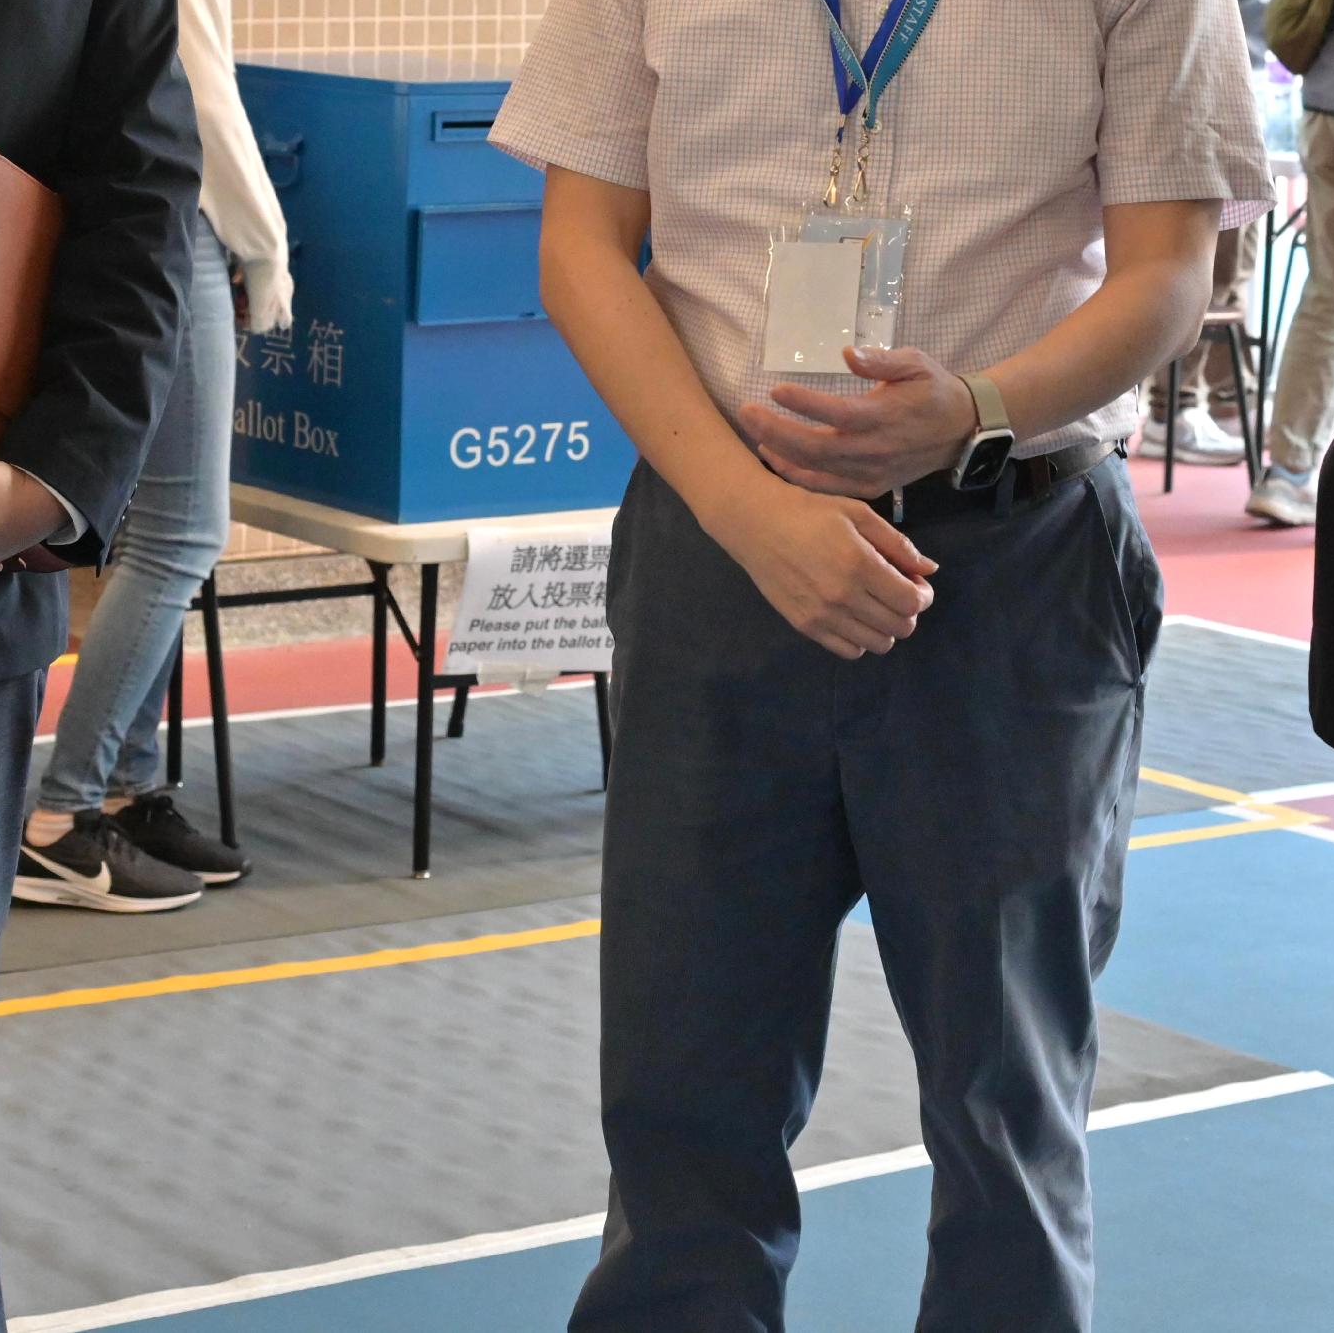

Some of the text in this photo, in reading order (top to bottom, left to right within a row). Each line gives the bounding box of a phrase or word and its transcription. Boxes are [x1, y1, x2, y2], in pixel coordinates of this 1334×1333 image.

[234, 399, 339, 457] allot Box
[449, 421, 590, 469] G5275
[510, 544, 611, 573] 請將選票
[469, 615, 608, 633] Please put the ball
[448, 639, 494, 656] paper
[498, 637, 527, 651] into
[531, 637, 554, 650] the
[558, 636, 602, 649] ballot
